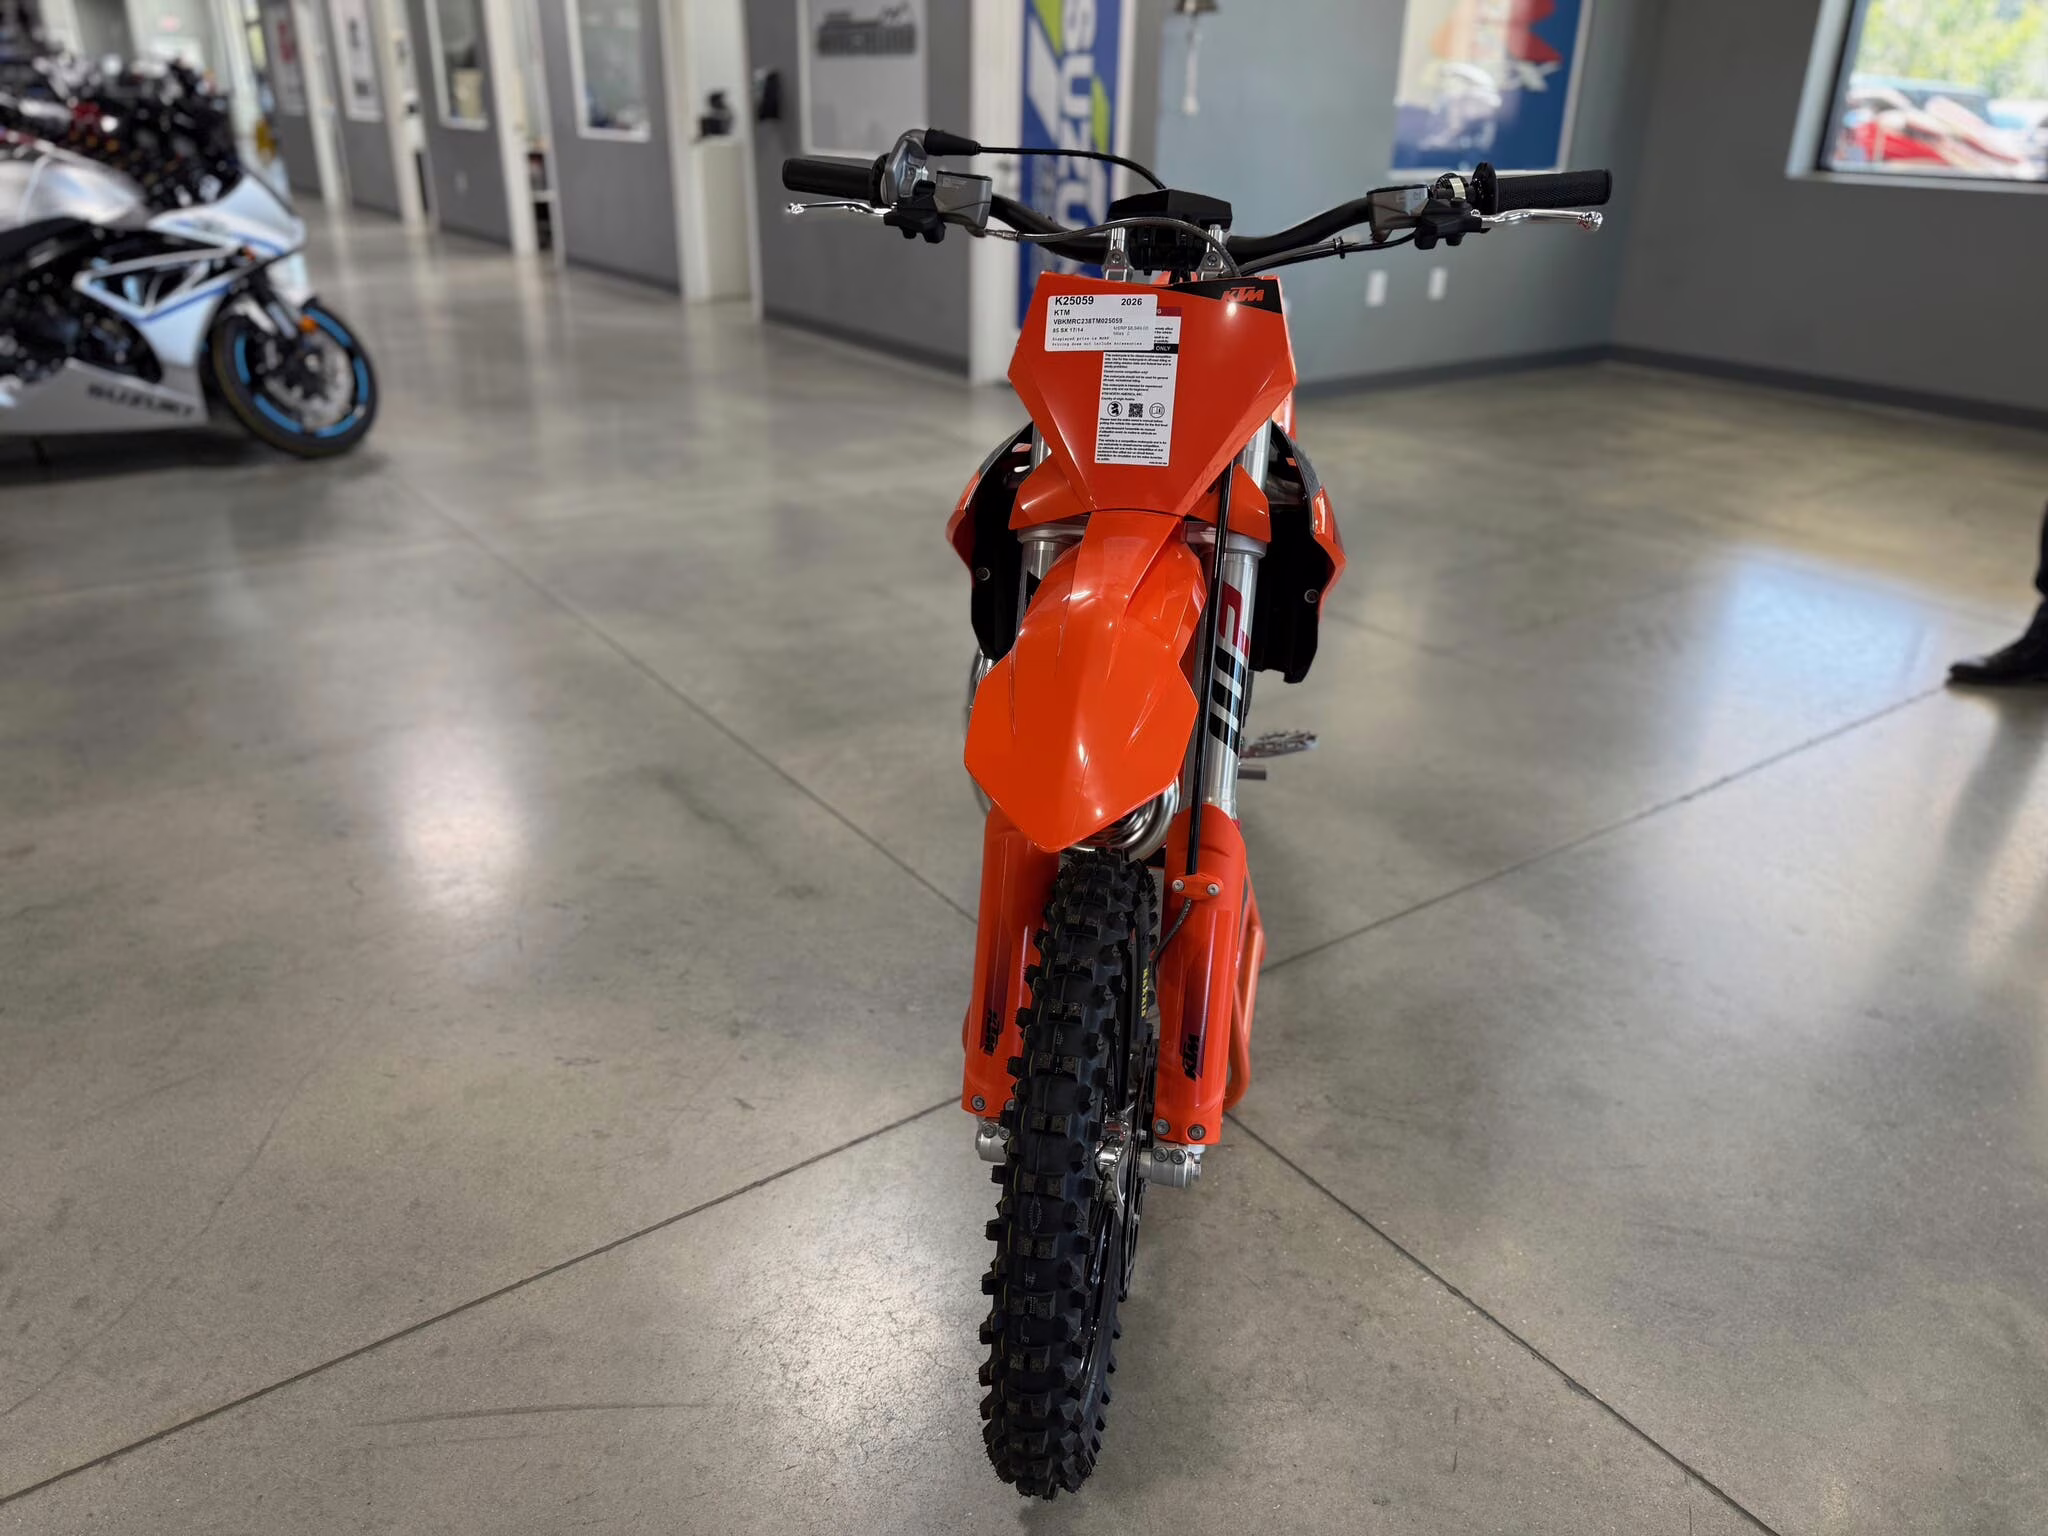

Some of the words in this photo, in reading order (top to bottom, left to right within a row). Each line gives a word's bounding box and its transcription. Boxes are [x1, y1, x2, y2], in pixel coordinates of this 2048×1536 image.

[1056, 0, 1098, 273] SUZU
[1055, 296, 1094, 305] K25059
[1121, 298, 1142, 306] 2026
[1221, 287, 1265, 302] KTM
[983, 1008, 1000, 1056] KTM
[1182, 1033, 1200, 1081] KTM
